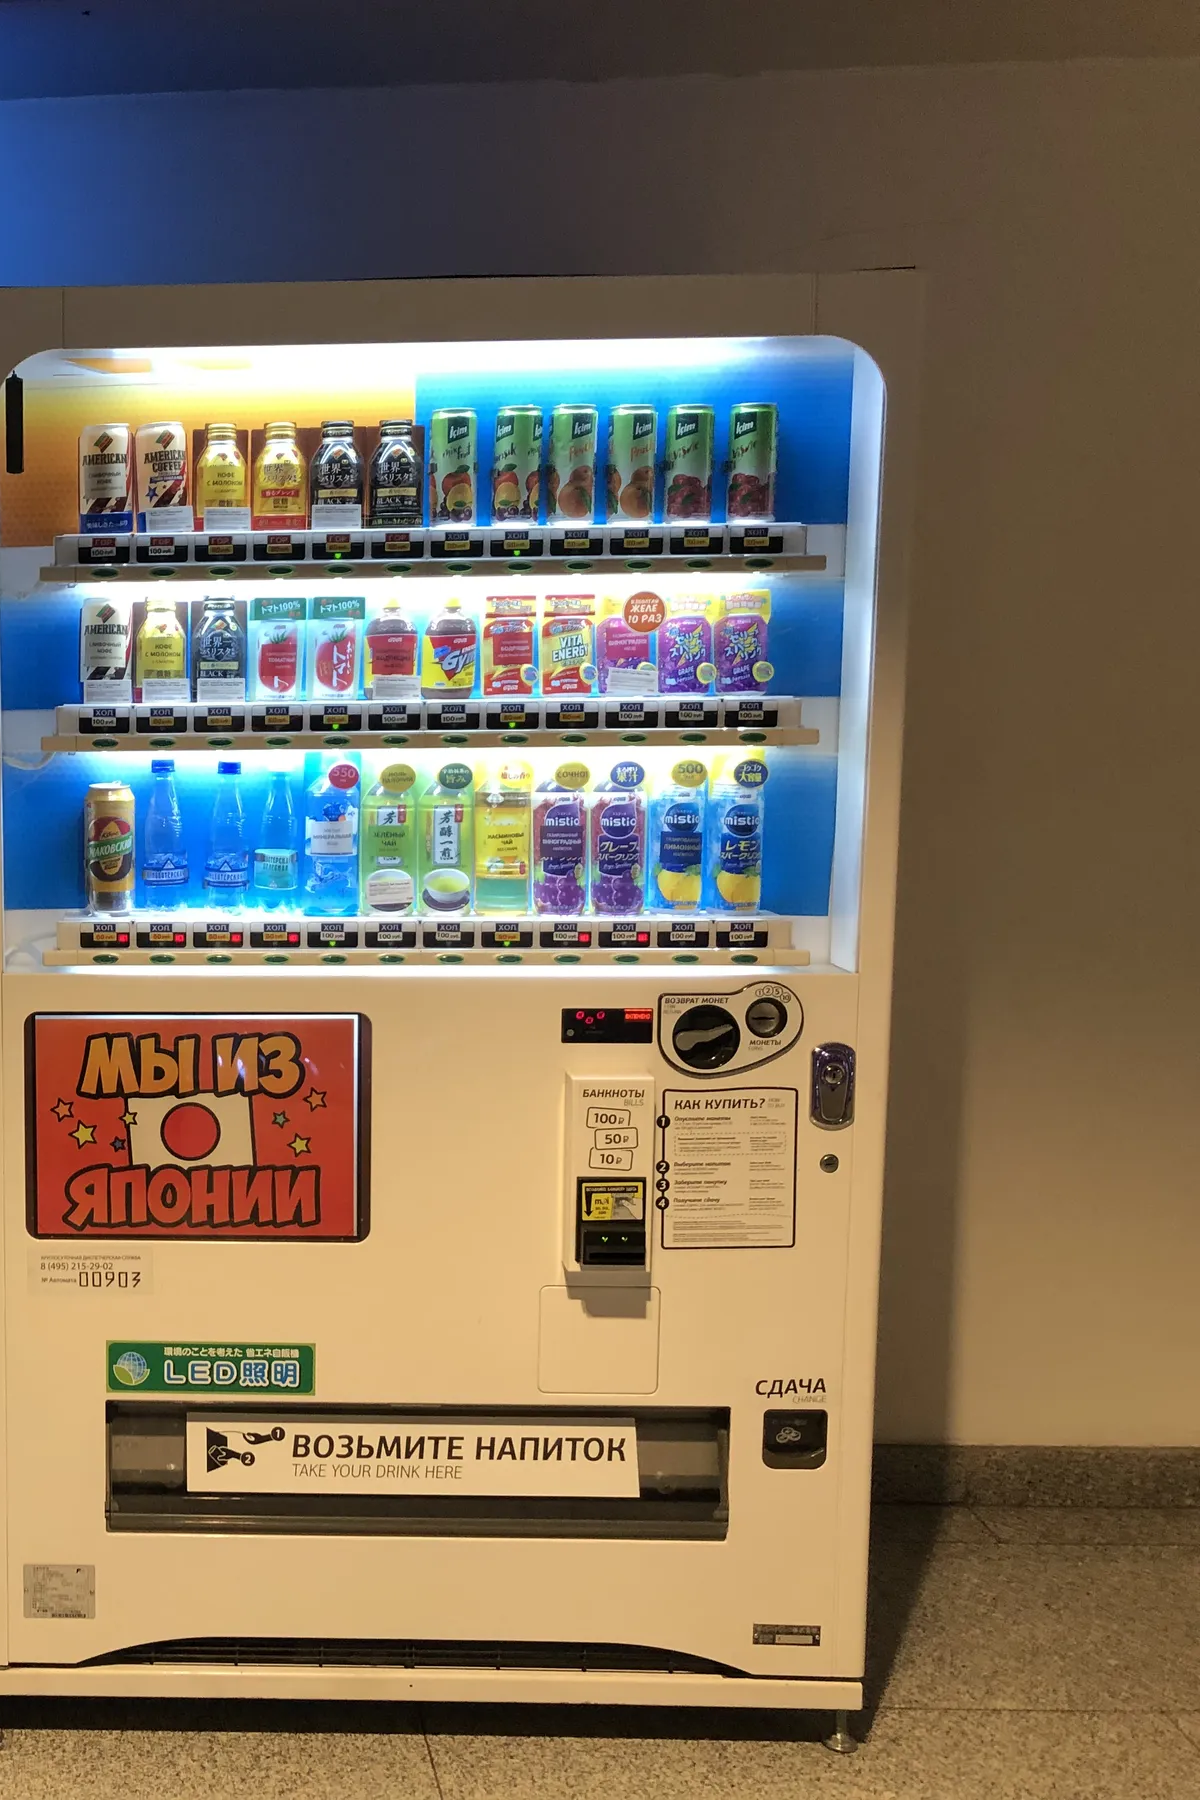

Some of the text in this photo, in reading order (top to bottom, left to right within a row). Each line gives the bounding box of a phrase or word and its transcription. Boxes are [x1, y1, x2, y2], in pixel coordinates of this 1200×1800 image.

[82, 452, 127, 467] AMERICAN
[143, 450, 186, 465] AMERICAN
[152, 461, 182, 473] COFFEE
[262, 600, 301, 615] トマト100%
[320, 599, 360, 614] トマト100%
[630, 604, 658, 613] ЖЕЛЕ
[627, 614, 663, 624] 10 РАЗ
[84, 624, 129, 636] AMERICAN
[560, 634, 583, 649] VITA
[552, 644, 588, 662] ENERGY
[678, 665, 695, 676] GRAPE
[333, 768, 356, 778] 550
[677, 763, 704, 774] 500
[445, 774, 466, 784] 旨み
[617, 772, 639, 783] 果汁
[739, 771, 762, 782] 大容量
[383, 811, 397, 825] 芳
[545, 817, 580, 827] mistio
[601, 817, 637, 827] mistio
[664, 815, 700, 825] mistio
[724, 815, 760, 826] mistio
[381, 839, 397, 847] ЧАЙ
[725, 840, 759, 851] レモン
[322, 924, 343, 932] ХОЛ
[664, 997, 700, 1005] ВОЗВРАТ
[76, 1032, 306, 1099] МЫ ИЗ
[582, 1089, 645, 1098] БАНКНОТЫ
[623, 1099, 644, 1107] BILLS
[674, 1098, 766, 1110] КАК КУПИТЬ?
[62, 1163, 321, 1231] ЯПОНИИ
[40, 1262, 113, 1271] 8 (495) 215-29-02
[78, 1271, 141, 1288] 00903
[164, 1347, 243, 1357] 環境のことを考えた
[164, 1359, 300, 1388] LED照明
[755, 1378, 826, 1399] СДАЧА
[792, 1395, 827, 1404] CHANGE
[291, 1435, 627, 1462] ВОЗЬМИТЕ НАПИТОК
[291, 1464, 463, 1479] TAKE YOUR DRINK HERE
